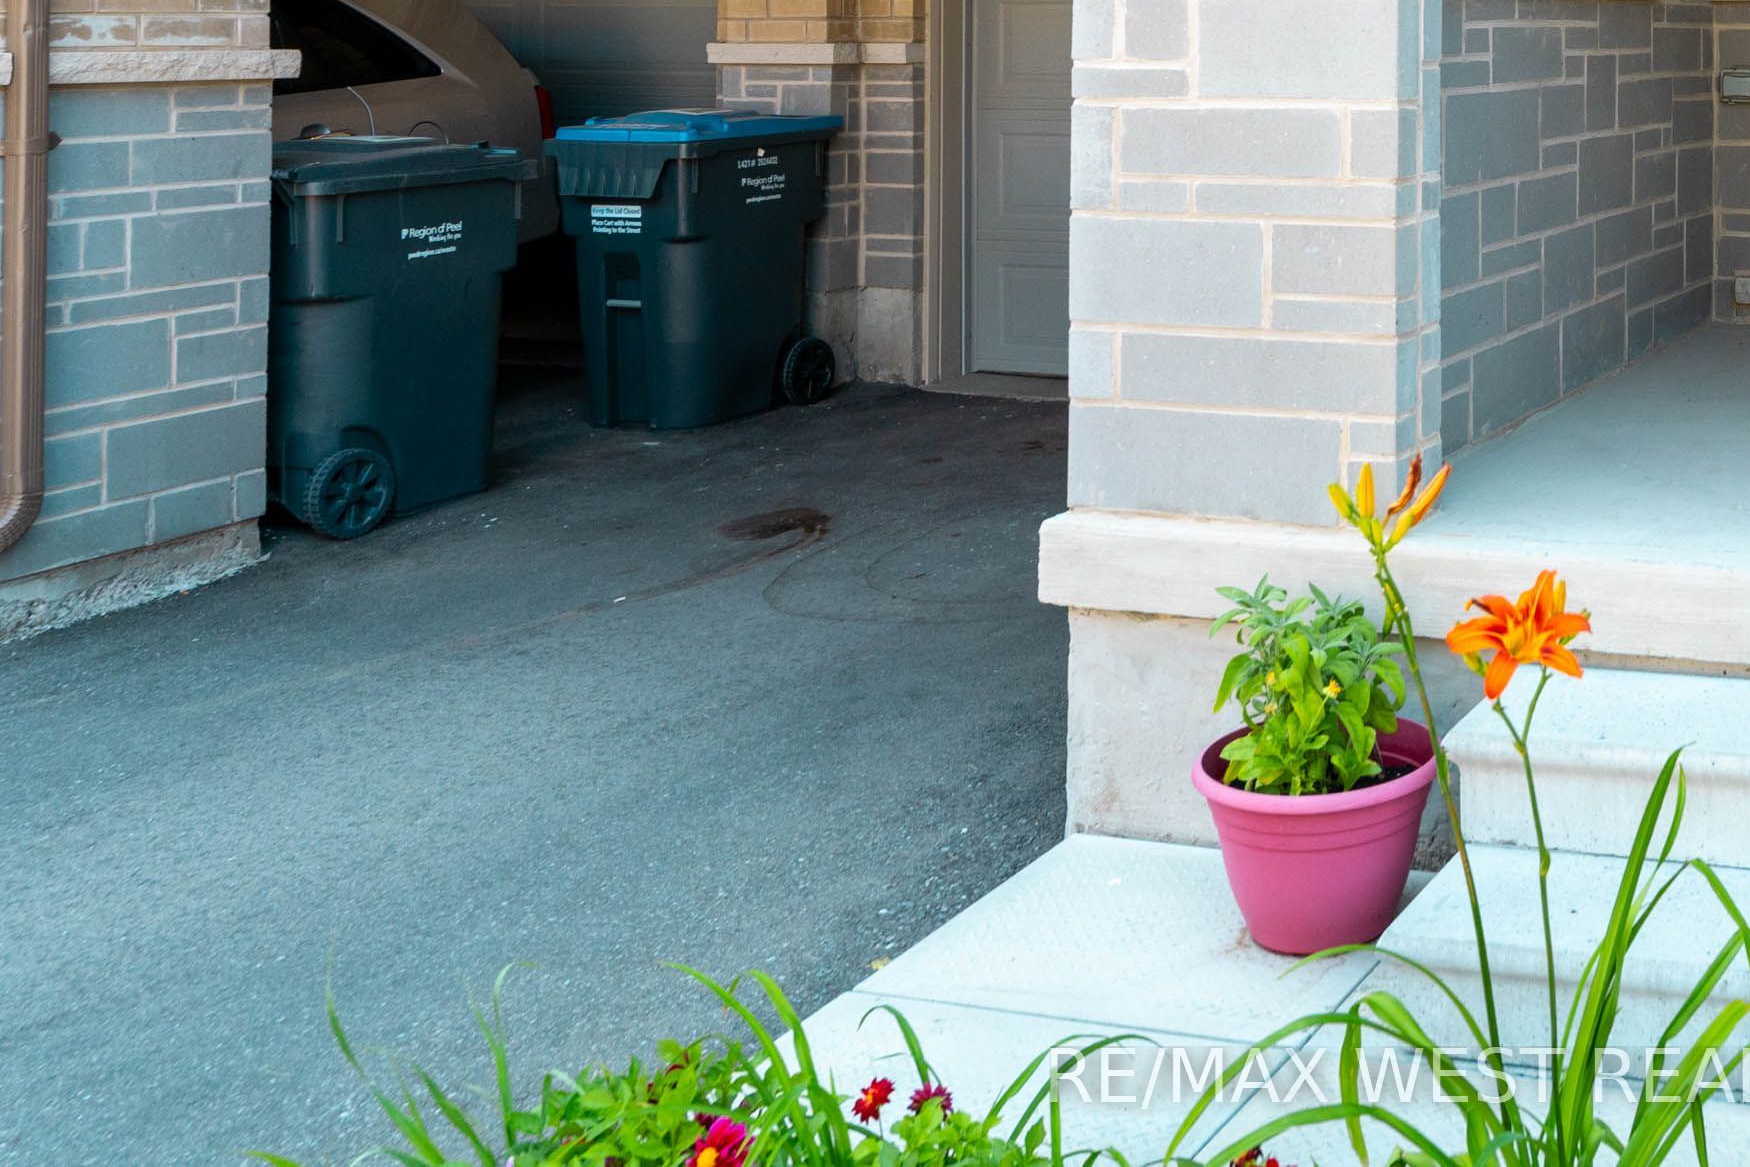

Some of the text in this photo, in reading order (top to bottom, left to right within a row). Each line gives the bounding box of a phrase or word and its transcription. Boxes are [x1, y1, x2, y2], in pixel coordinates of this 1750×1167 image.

[409, 220, 463, 240] Region of Peel
